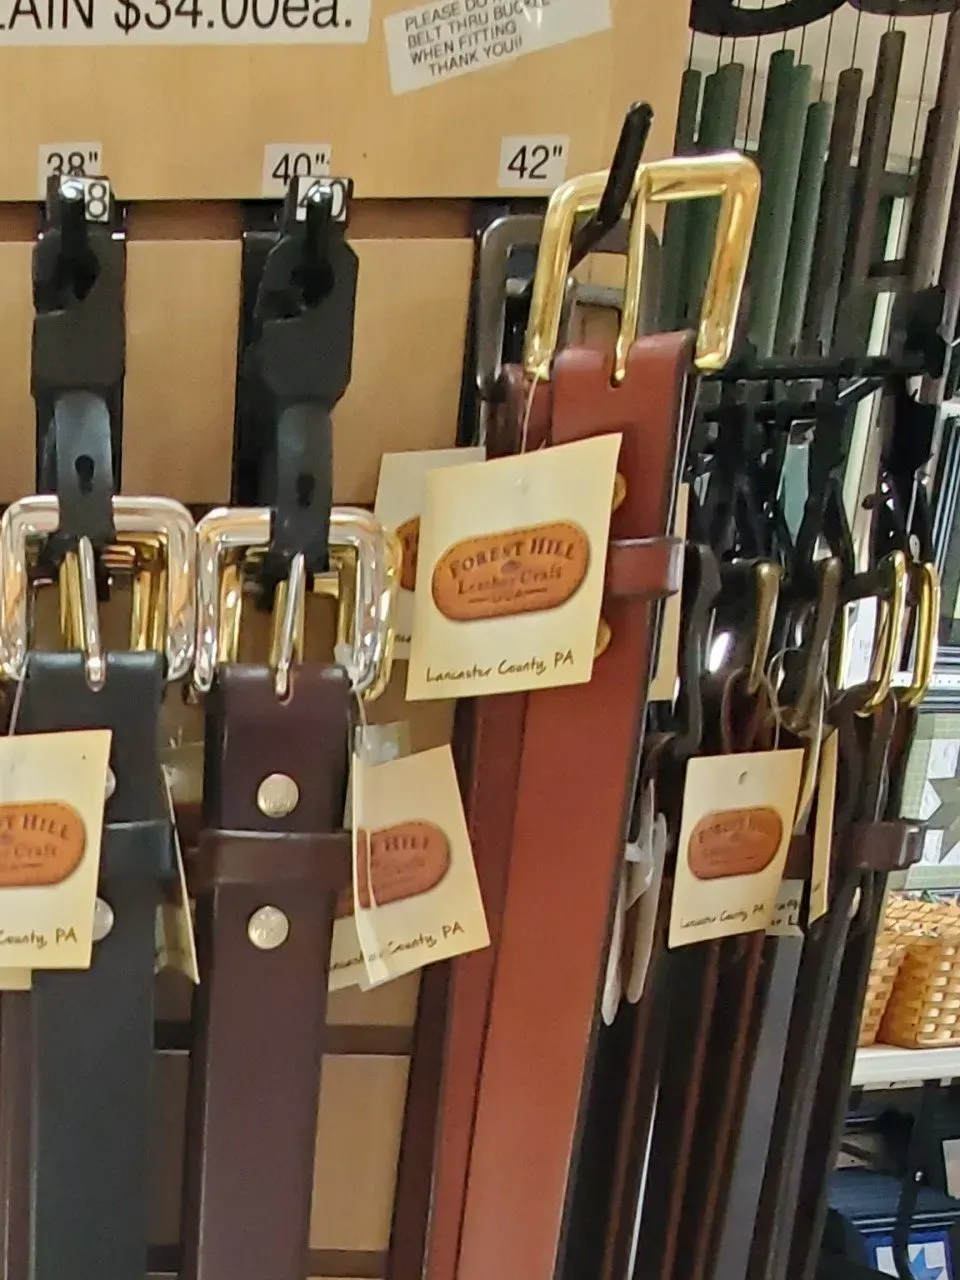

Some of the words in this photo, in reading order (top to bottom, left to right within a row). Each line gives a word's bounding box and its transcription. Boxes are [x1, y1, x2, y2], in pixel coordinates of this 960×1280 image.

[114, 0, 352, 35] $34.00ea.
[404, 0, 461, 32] PLEASE
[407, 26, 446, 49] BELT
[448, 13, 489, 35] THRU
[410, 37, 454, 65] WHEN
[458, 19, 517, 49] FITTING
[429, 52, 479, 77] THANK
[272, 153, 325, 186] 40"
[507, 144, 562, 179] 42"
[449, 541, 525, 579] FOREST
[530, 537, 575, 561] HILL
[426, 663, 492, 682] Lancaster
[554, 648, 574, 668] PA
[22, 813, 69, 840] HILL
[55, 926, 77, 944] PA
[442, 921, 465, 938] PA
